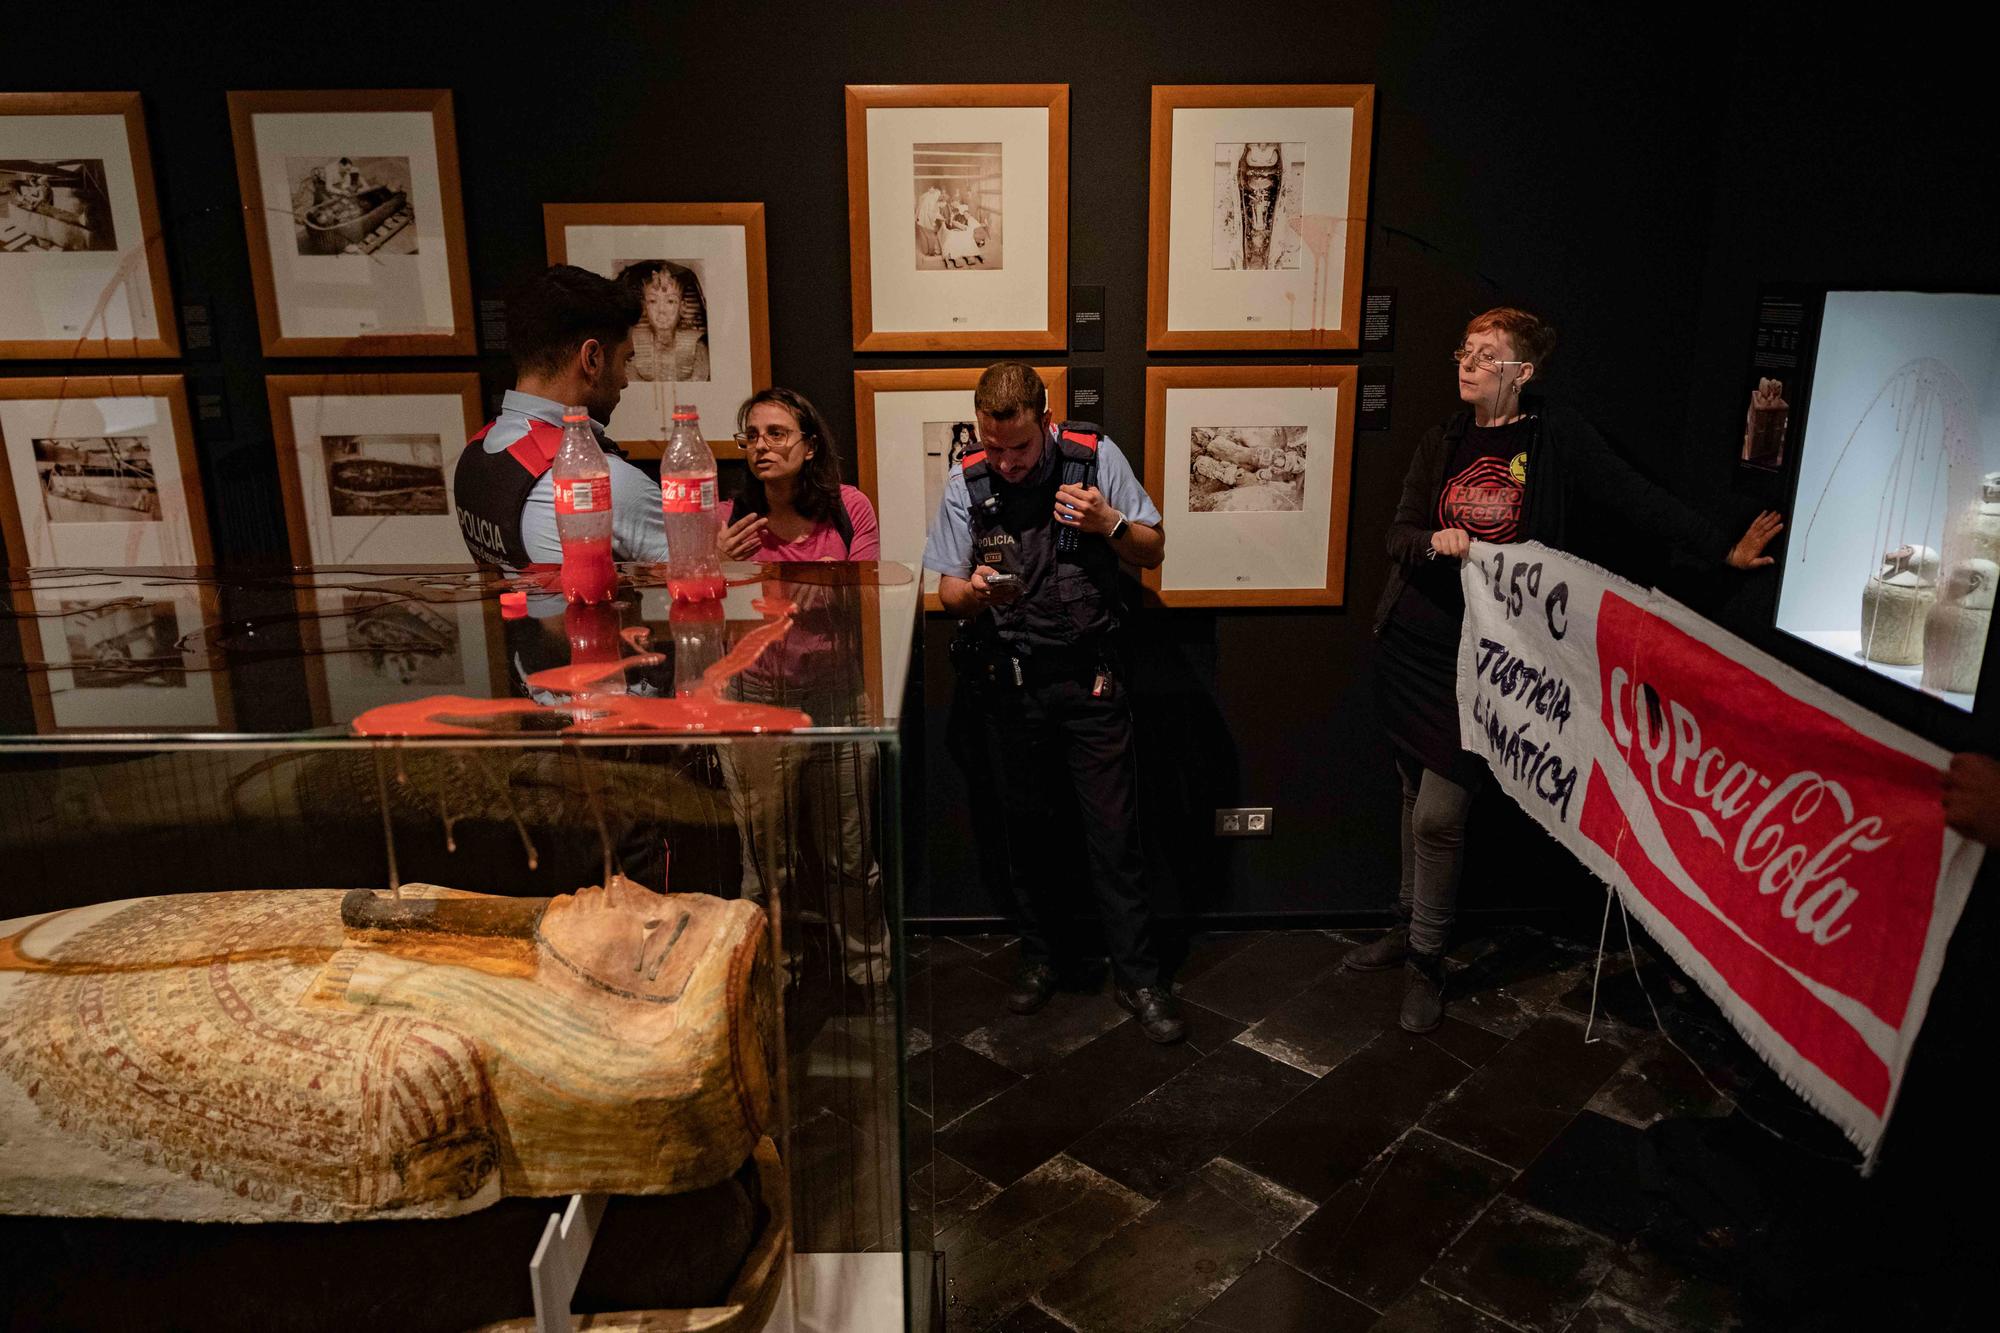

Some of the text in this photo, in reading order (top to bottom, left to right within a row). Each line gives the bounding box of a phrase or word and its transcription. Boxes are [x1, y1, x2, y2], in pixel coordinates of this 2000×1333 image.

[1456, 487, 1522, 504] FUTURO
[457, 506, 507, 554] POLICIA
[978, 534, 1015, 548] POLICIA
